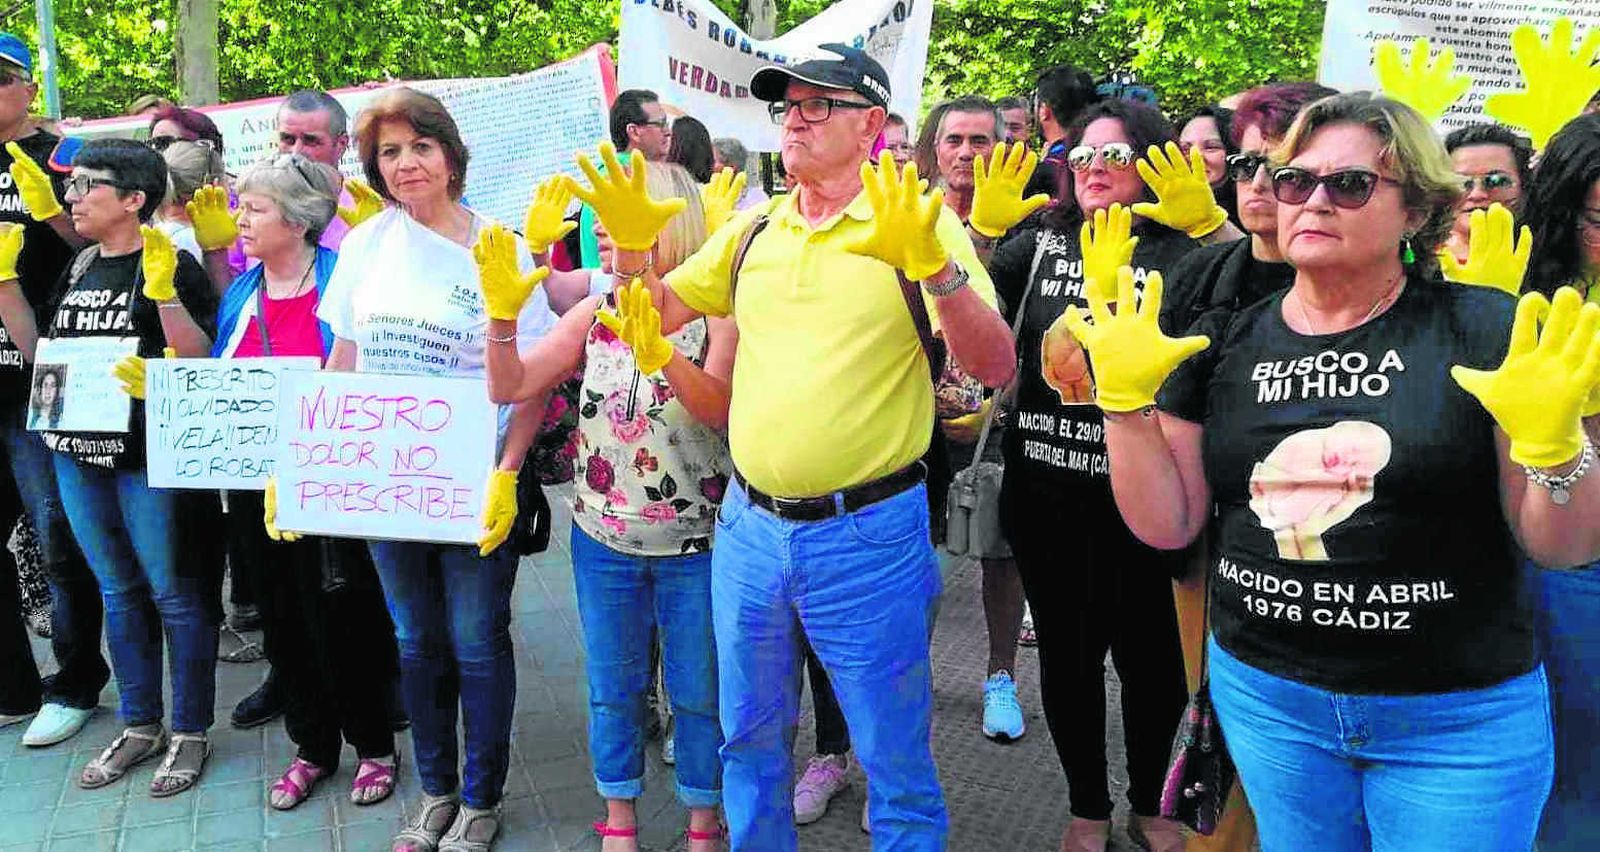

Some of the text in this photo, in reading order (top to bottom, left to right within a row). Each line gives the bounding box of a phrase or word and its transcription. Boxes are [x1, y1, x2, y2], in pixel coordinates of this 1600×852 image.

[1430, 12, 1451, 22] que
[1440, 37, 1481, 47] vuestra
[1456, 50, 1492, 61] uestro
[1467, 65, 1513, 76] muchas
[417, 318, 462, 341] Jueces
[383, 330, 450, 352] Investiguen
[363, 347, 410, 358] nuestros
[1251, 349, 1405, 381] BUSCO A
[1257, 373, 1391, 404] MI HIJO
[177, 397, 276, 417] OLVIDADO
[300, 385, 452, 432] NUESTRO
[1059, 418, 1073, 438] EL
[288, 440, 438, 471] DOLOR NO
[1051, 446, 1067, 467] DEL
[1068, 450, 1089, 471] MAR
[176, 457, 203, 478] LO
[294, 480, 475, 519] PRESCRIBE
[1218, 557, 1455, 604] NACIDO EN ABRIL
[1242, 595, 1413, 630] 1976 CÁDIZ
